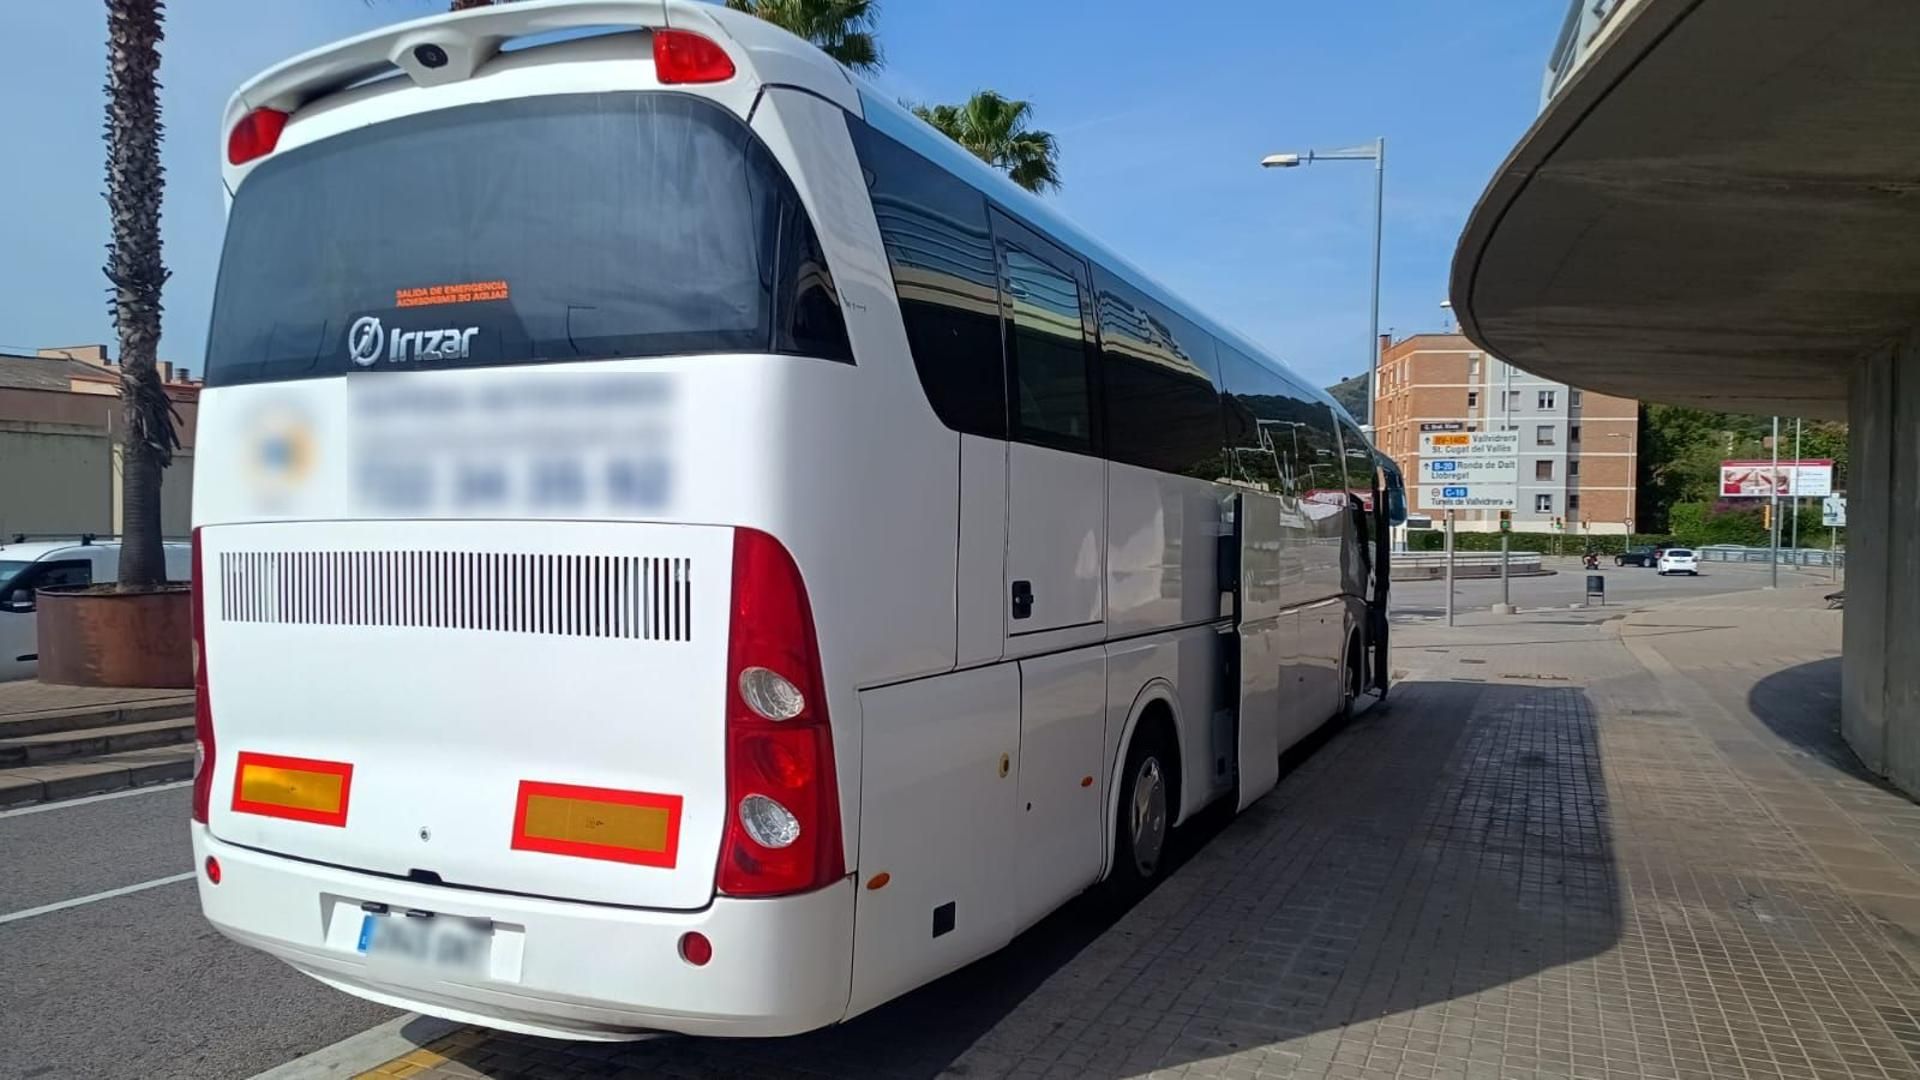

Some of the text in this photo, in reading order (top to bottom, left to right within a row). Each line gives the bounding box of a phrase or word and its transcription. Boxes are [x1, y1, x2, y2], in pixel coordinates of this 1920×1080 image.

[396, 281, 508, 298] SALIDA DE EMERGENCIA
[389, 326, 479, 362] Irizar
[1472, 434, 1517, 443] Vallvidrera
[1445, 445, 1470, 454] Cugat
[1472, 445, 1485, 453] del
[1434, 460, 1516, 470] B-20 Ronda de Dalt
[1432, 472, 1470, 480] Llobregat
[1456, 498, 1465, 506] de
[1466, 497, 1504, 506] Vallvidrera
